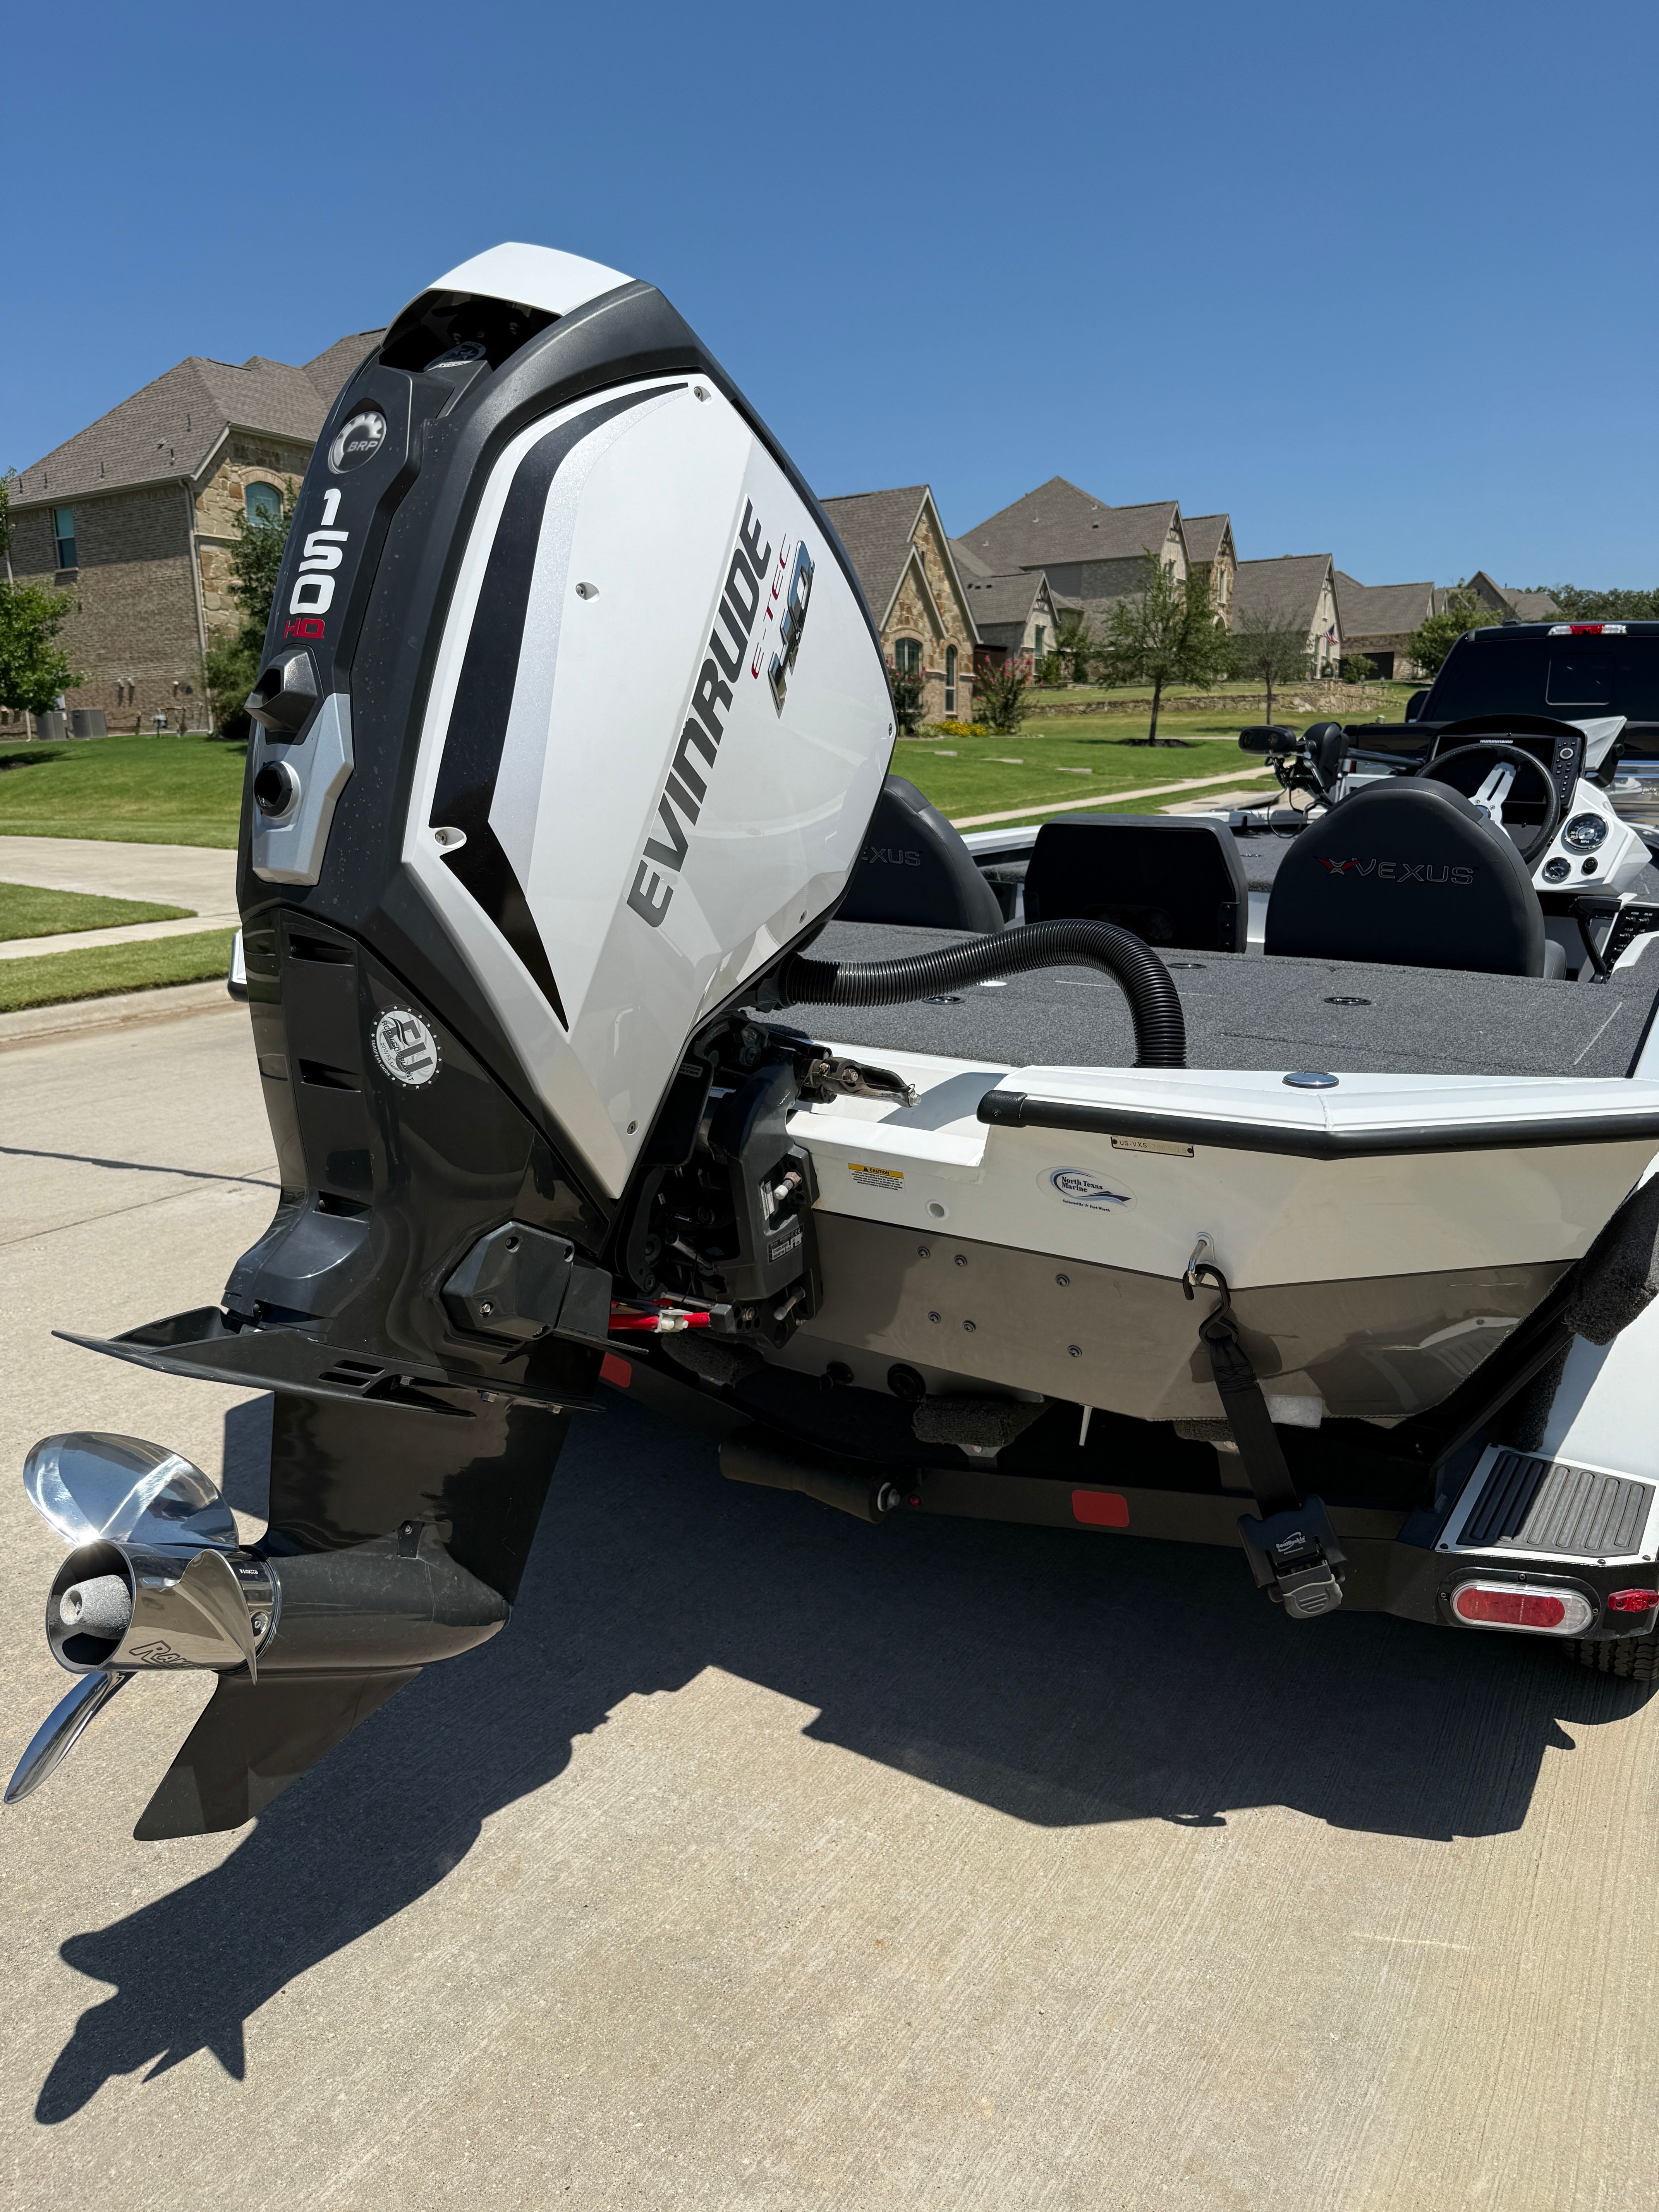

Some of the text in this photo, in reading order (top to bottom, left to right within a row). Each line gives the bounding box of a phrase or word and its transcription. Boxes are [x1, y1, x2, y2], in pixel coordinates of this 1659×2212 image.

[349, 440, 378, 452] BRP
[289, 488, 349, 615] 150
[751, 533, 791, 680] E-TEC
[626, 496, 772, 927] EVINRUDE
[861, 846, 921, 866] XUS
[1352, 857, 1473, 884] VEXUS
[381, 1021, 392, 1036] RCD
[371, 1040, 391, 1077] EUROPEAN UNION
[1061, 1176, 1103, 1190] North Texas
[1062, 1182, 1087, 1192] Marine
